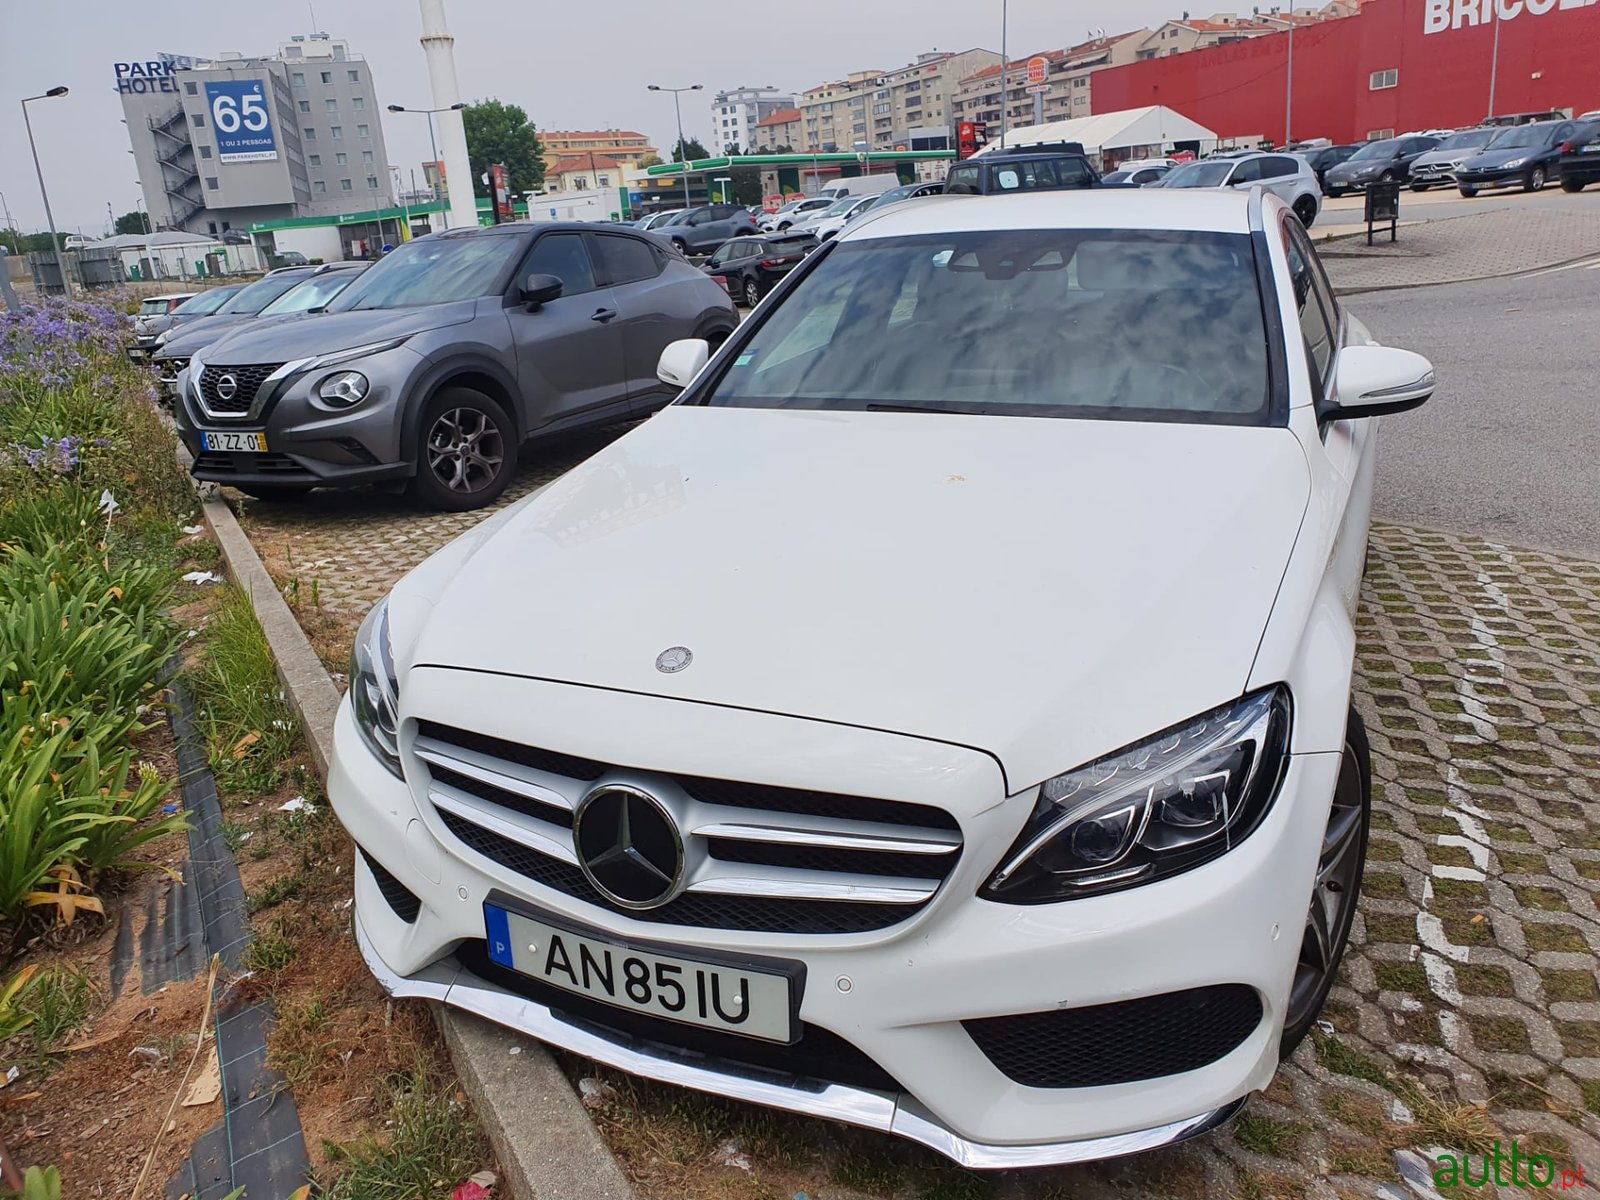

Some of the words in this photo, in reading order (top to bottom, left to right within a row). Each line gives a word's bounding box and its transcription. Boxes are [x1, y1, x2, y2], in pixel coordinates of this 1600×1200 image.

[1424, 0, 1595, 34] BRIC
[114, 61, 176, 77] PARK
[1028, 70, 1045, 78] KING
[117, 76, 180, 94] HOTEL
[213, 94, 268, 133] 65
[242, 138, 272, 146] PESSOAS
[496, 941, 505, 954] P
